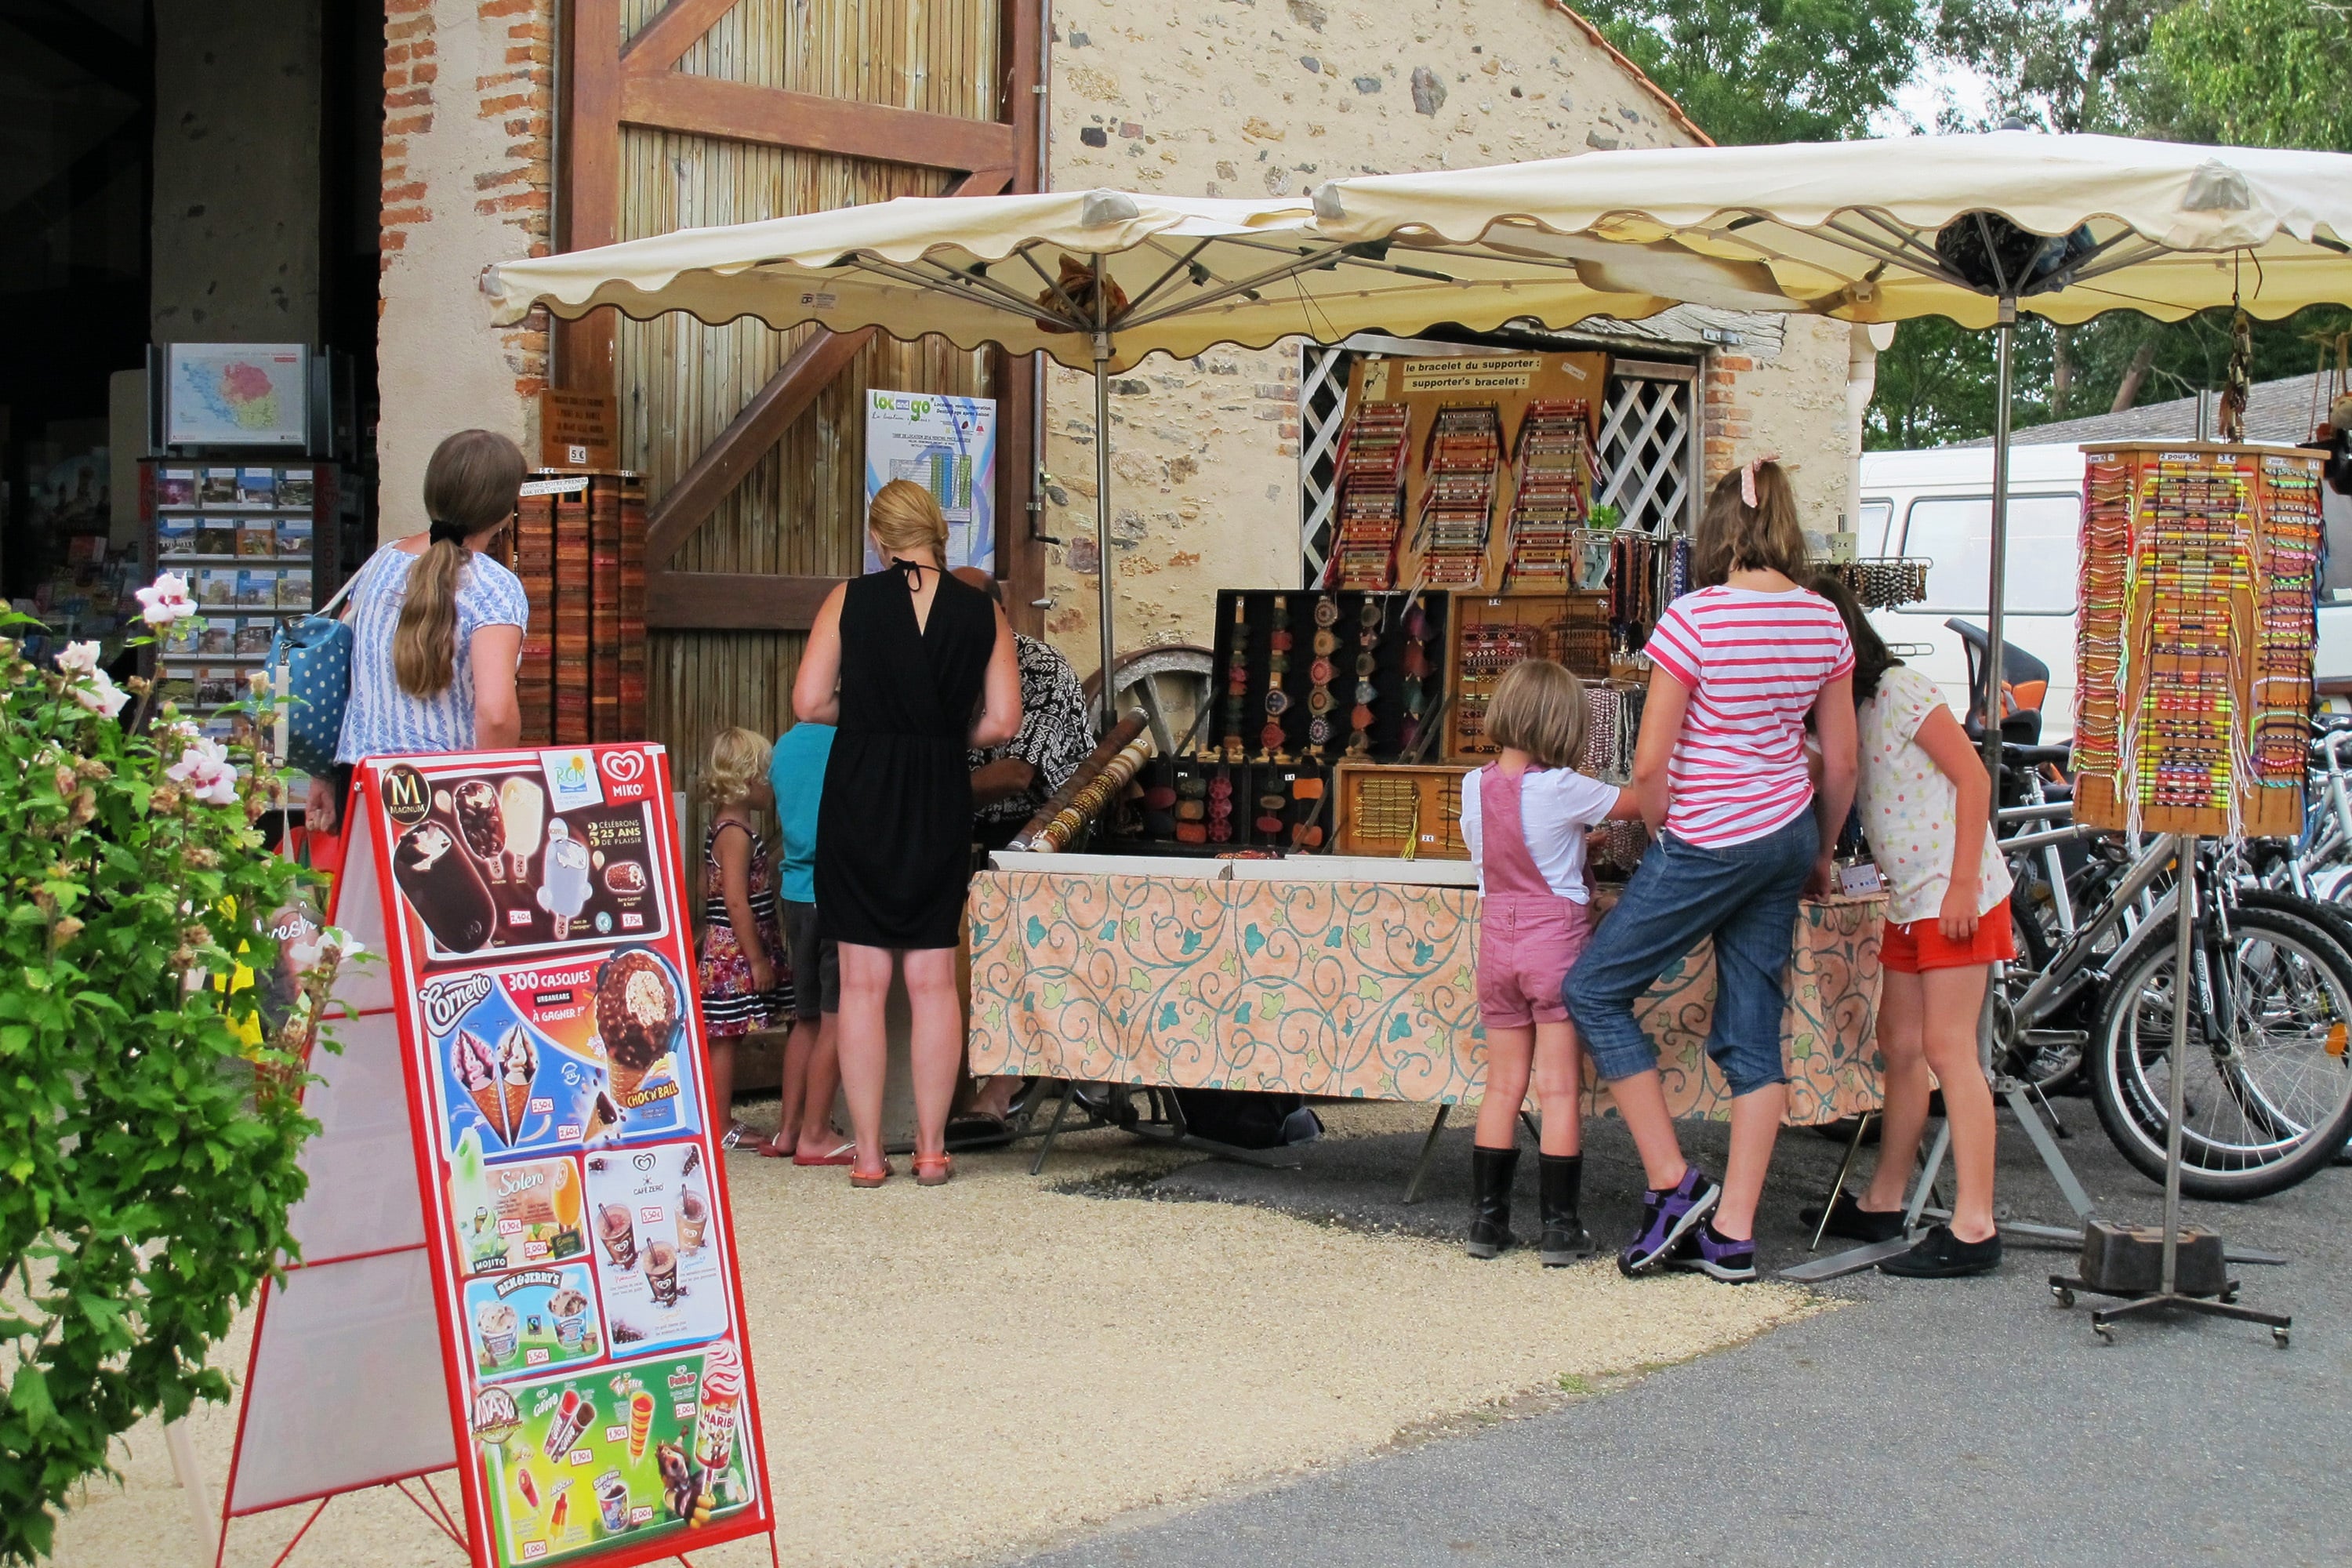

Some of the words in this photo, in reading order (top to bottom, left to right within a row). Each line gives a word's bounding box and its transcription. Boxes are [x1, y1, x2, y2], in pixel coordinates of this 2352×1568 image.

[1406, 363, 1416, 372] le
[1417, 361, 1461, 372] bracelet
[1465, 361, 1479, 370] du
[1482, 359, 1534, 370] supporter
[1412, 377, 1471, 388] supporter's
[1475, 376, 1519, 387] bracelet
[911, 399, 931, 422] go
[612, 784, 642, 797] MIKO
[390, 804, 426, 815] MAGNUM
[598, 819, 640, 829] CÉLÉBRONS
[601, 829, 615, 838] 25
[618, 827, 641, 837] ANS
[615, 837, 642, 845] PLAISIR
[509, 971, 539, 992] 300
[540, 970, 591, 988] CASQUES
[418, 974, 492, 1036] Cornetto
[536, 993, 570, 1004] URBANEARS
[532, 1009, 540, 1023] À
[542, 1007, 575, 1022] GAGNER
[498, 1171, 544, 1197] Solero
[475, 1257, 506, 1271] MOJITO
